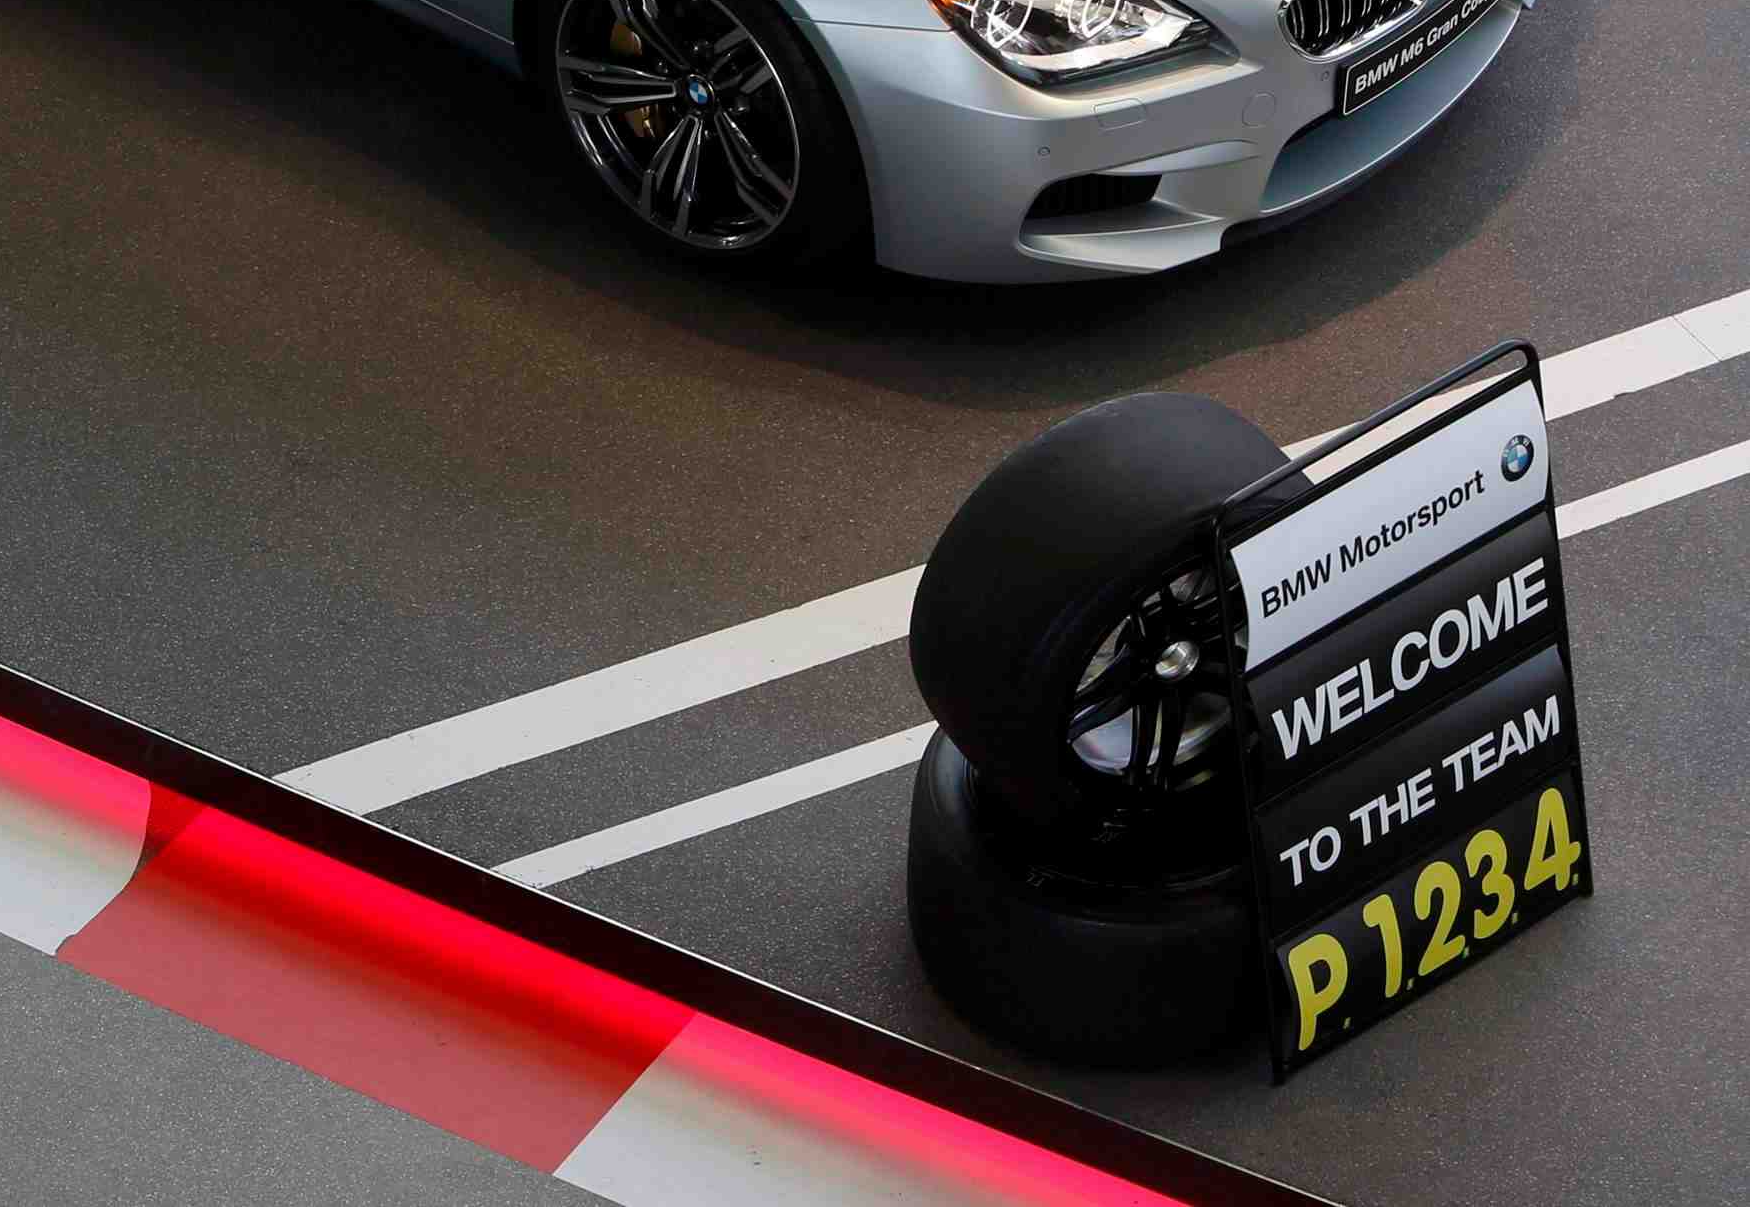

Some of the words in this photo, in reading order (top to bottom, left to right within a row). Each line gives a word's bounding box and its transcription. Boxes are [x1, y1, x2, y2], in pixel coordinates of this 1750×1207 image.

[1355, 54, 1398, 94] BMW
[1401, 37, 1424, 66] M6
[1427, 14, 1458, 46] Gran
[1261, 553, 1333, 617] BMW
[1340, 469, 1485, 571] Motorsport
[1271, 557, 1548, 759] WELCOME
[1280, 826, 1342, 886] TO
[1349, 770, 1436, 846] THE
[1443, 695, 1561, 792] TEAM
